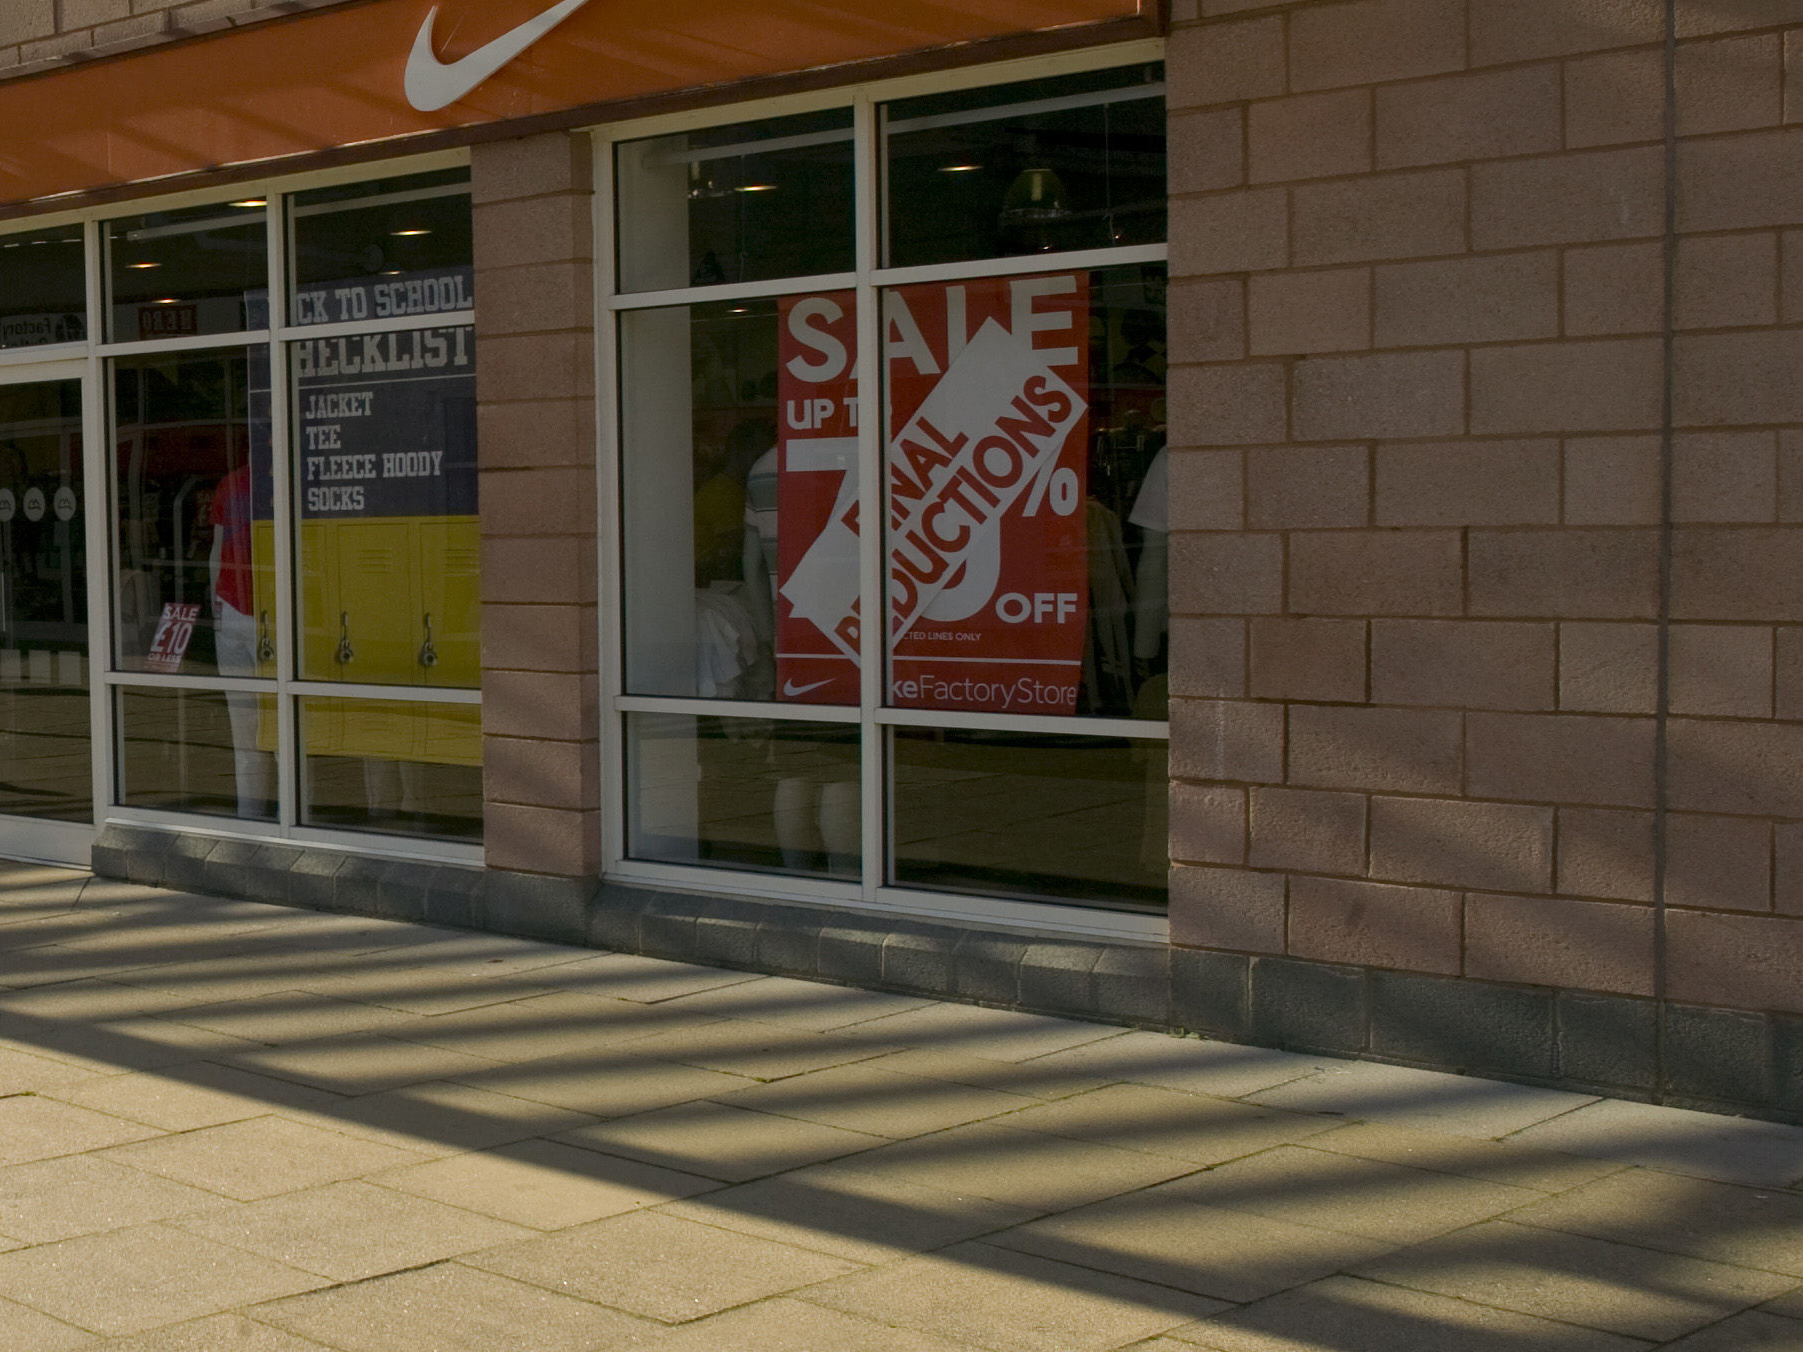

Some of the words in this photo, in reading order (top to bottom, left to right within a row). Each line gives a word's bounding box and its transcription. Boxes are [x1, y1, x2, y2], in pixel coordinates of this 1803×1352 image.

[335, 286, 368, 321] TO
[374, 275, 473, 317] SCHOOL
[298, 327, 473, 378] HECKLIST
[305, 391, 374, 420] JACKET
[785, 398, 835, 430] UP
[306, 425, 342, 450] TEE
[307, 454, 376, 480] FLEECE
[382, 451, 443, 478] HOODY
[308, 486, 365, 512] SOCKS
[162, 606, 199, 621] SALE
[995, 593, 1078, 624] OFF
[150, 622, 193, 654] £10
[927, 631, 953, 640] LINES
[954, 632, 982, 641] ONLY
[893, 675, 1077, 708] keFactoryStore
